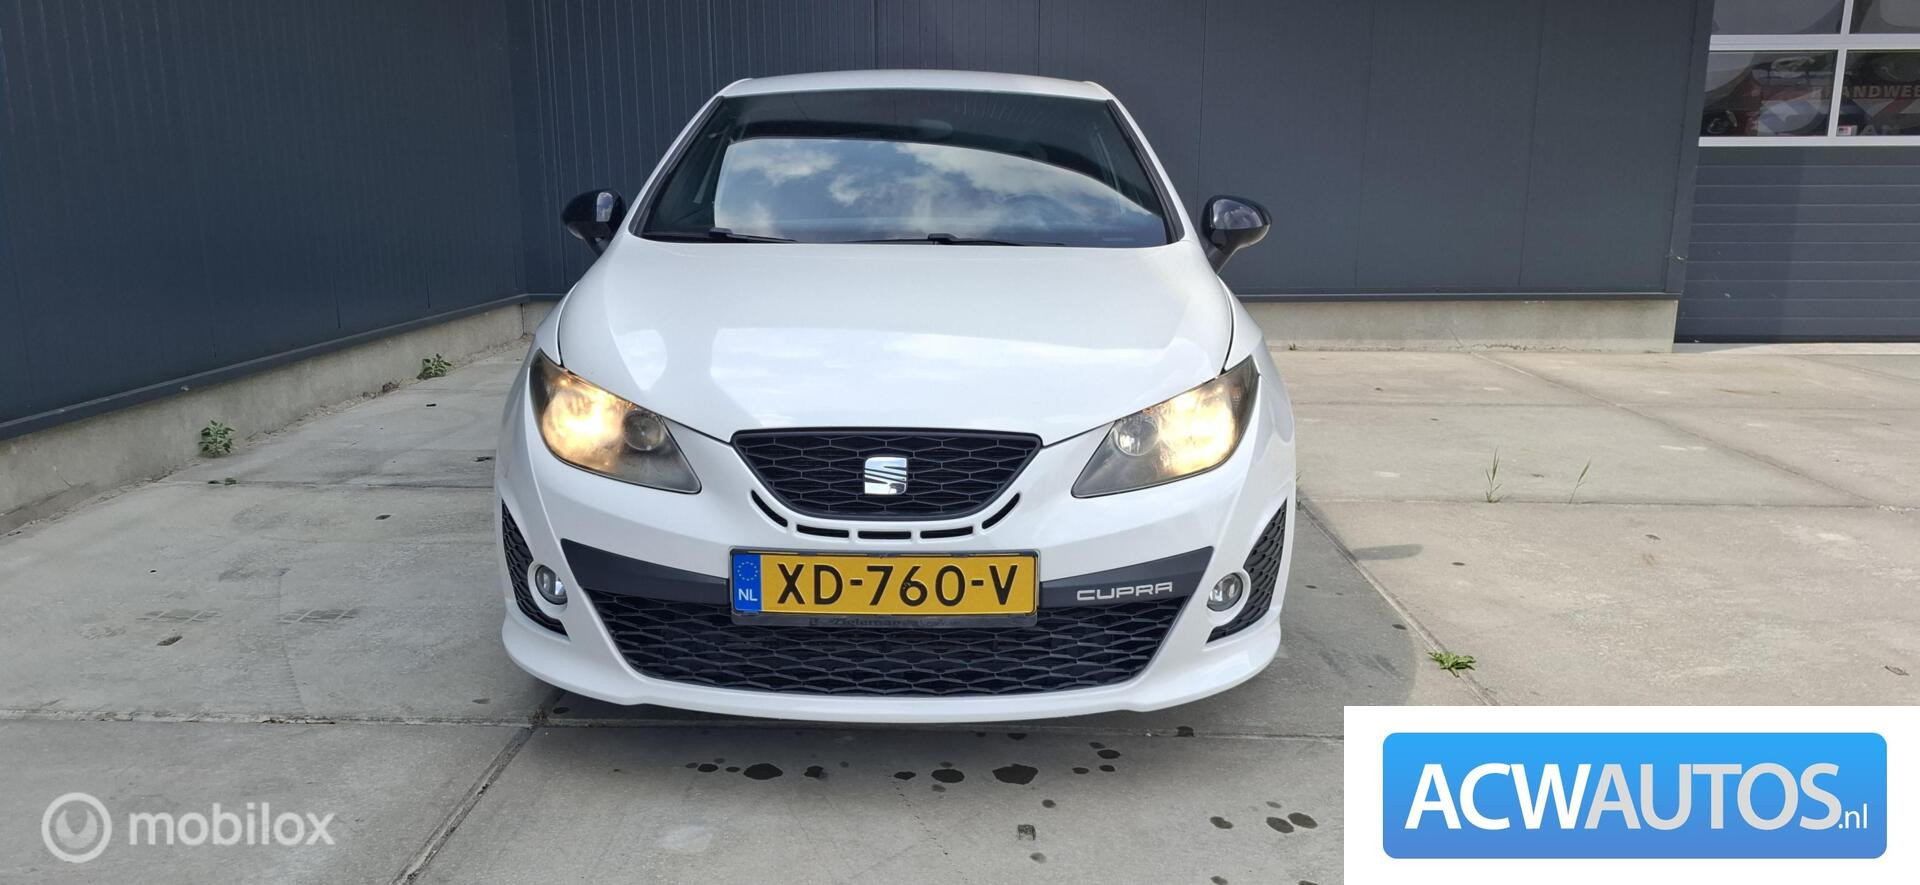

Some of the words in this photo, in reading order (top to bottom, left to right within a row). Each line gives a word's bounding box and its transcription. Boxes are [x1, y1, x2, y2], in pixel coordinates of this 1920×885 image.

[777, 562, 1018, 607] XD-760-V
[1076, 581, 1173, 601] CUPRA
[738, 588, 758, 602] NL
